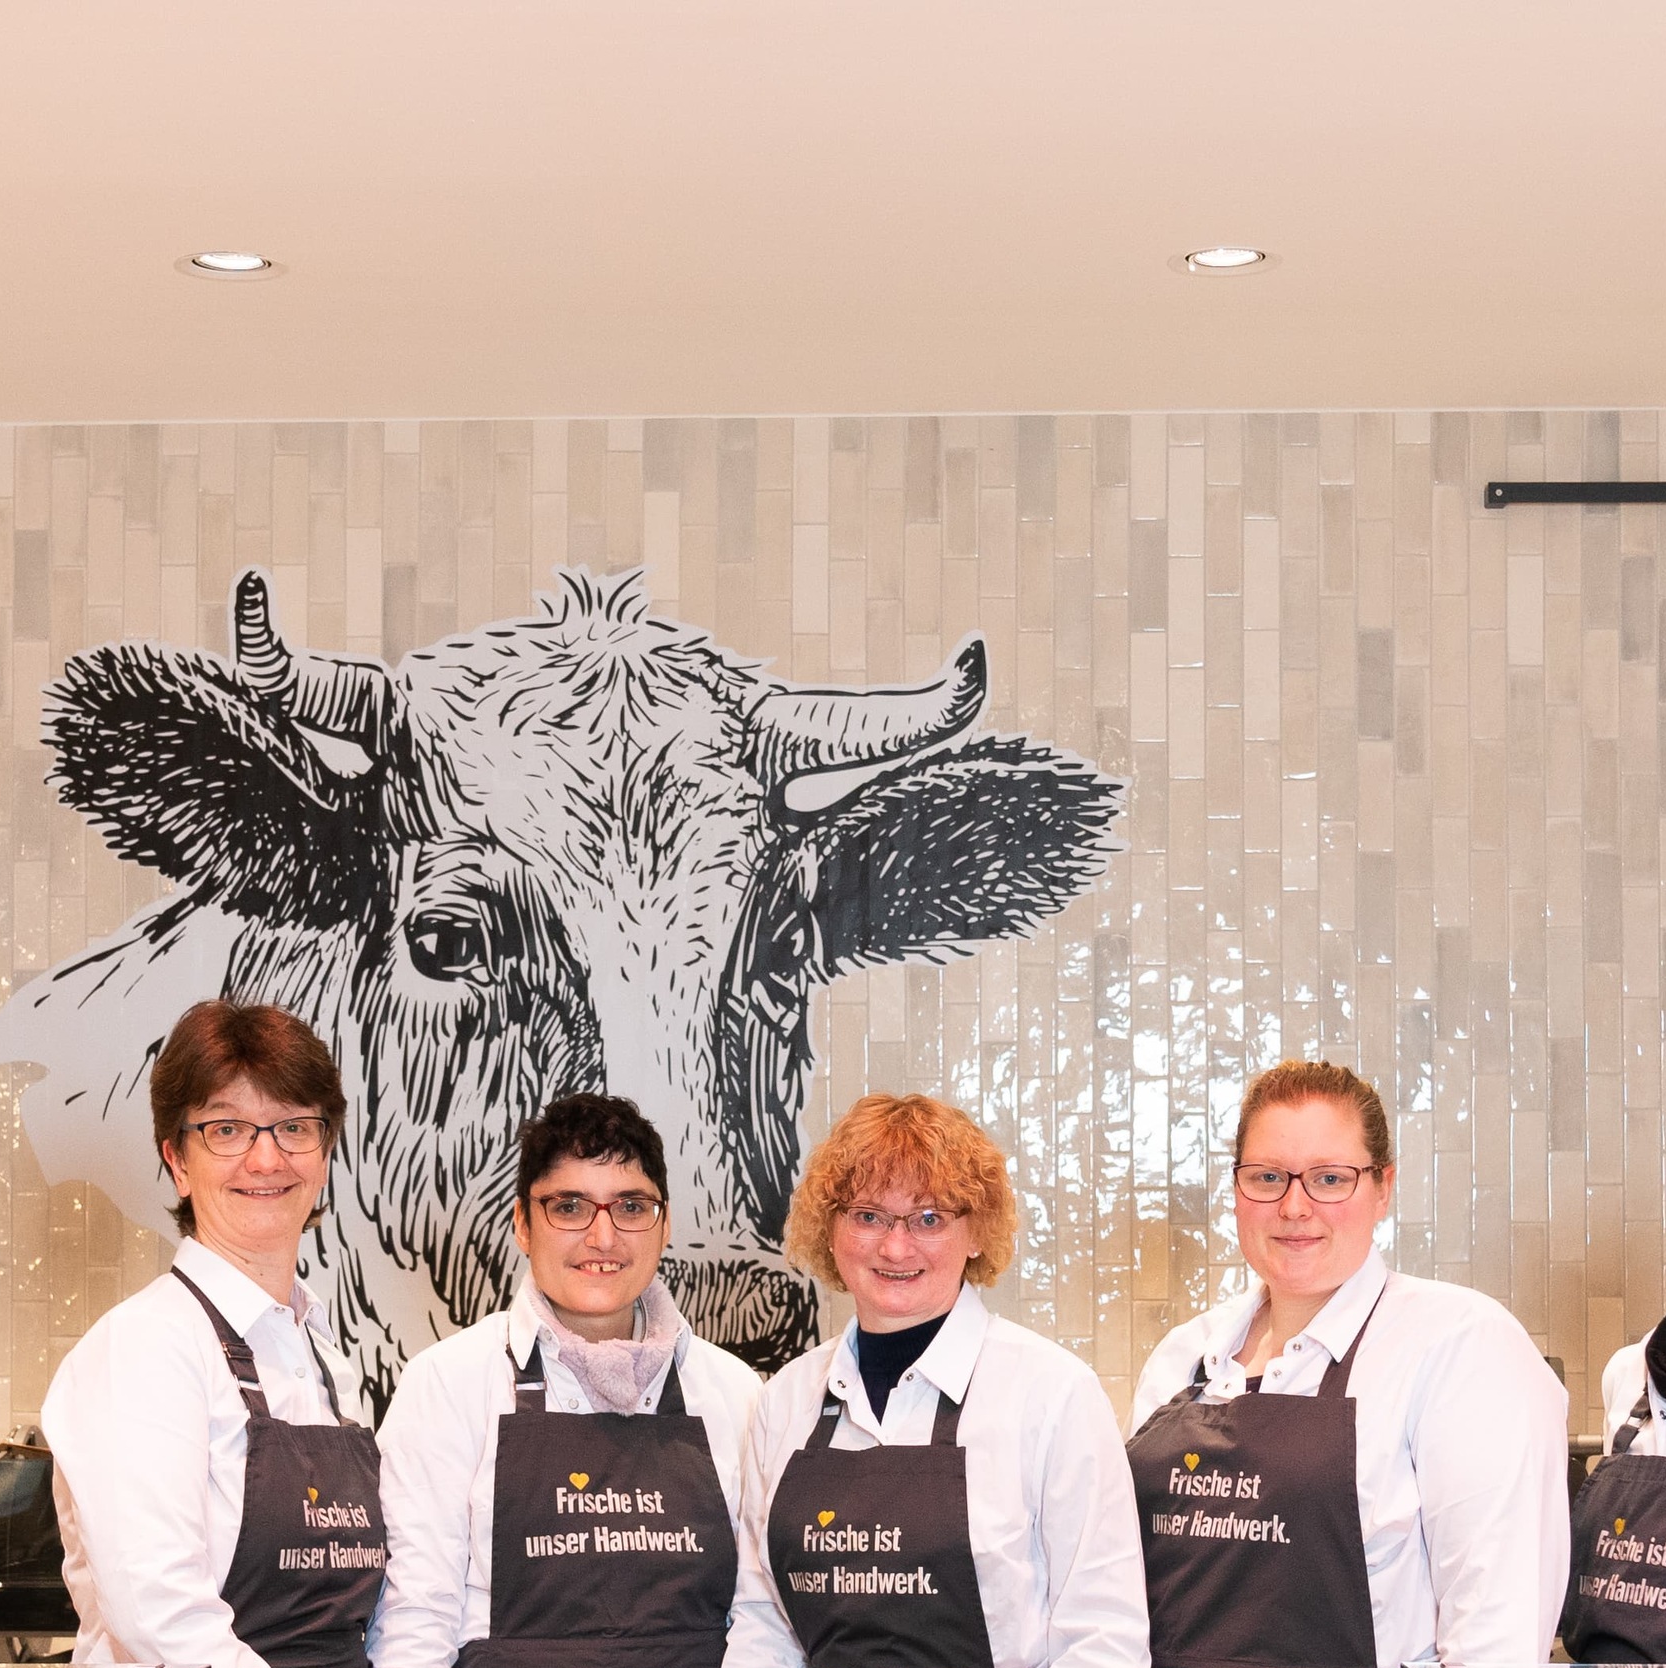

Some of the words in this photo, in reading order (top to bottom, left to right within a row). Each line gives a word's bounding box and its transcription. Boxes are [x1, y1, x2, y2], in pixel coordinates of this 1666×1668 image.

[1169, 1467, 1232, 1497] Frische
[1235, 1471, 1261, 1499] ist
[304, 1500, 350, 1528] Frische
[350, 1503, 371, 1528] ist
[557, 1488, 632, 1514] Frische
[635, 1489, 664, 1514] ist
[804, 1524, 869, 1553] Frische
[874, 1524, 902, 1552] ist
[1152, 1512, 1188, 1537] unser
[1188, 1510, 1291, 1543] Handwerk.
[525, 1532, 588, 1558] unser
[593, 1525, 704, 1554] Handwerk.
[1596, 1530, 1644, 1562] Frische
[279, 1545, 326, 1570] unser
[788, 1568, 829, 1595] unser
[833, 1566, 938, 1595] Handwerk.
